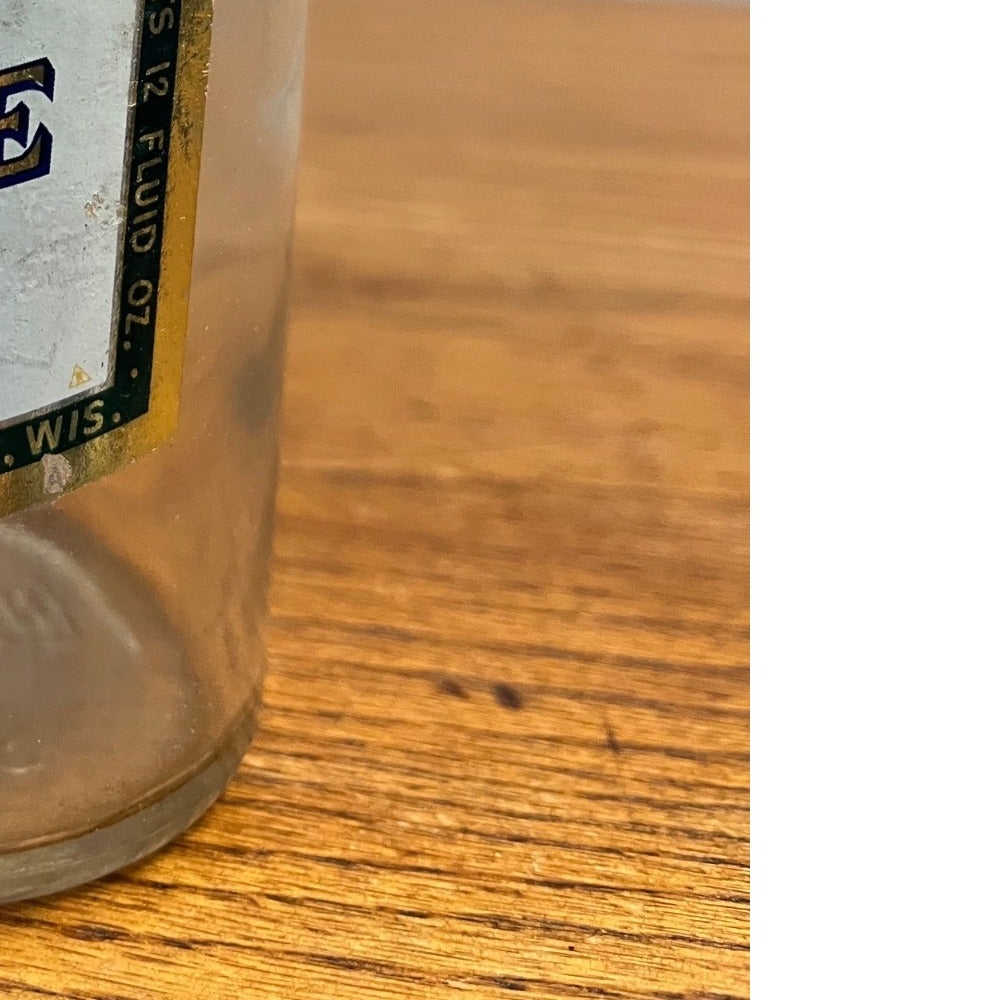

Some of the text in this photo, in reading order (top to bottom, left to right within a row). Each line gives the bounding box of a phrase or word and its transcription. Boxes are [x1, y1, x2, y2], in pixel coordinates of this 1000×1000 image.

[143, 61, 171, 102] 12
[131, 129, 165, 254] FLUID
[123, 279, 153, 350] OZ.
[26, 399, 122, 456] WIS.
